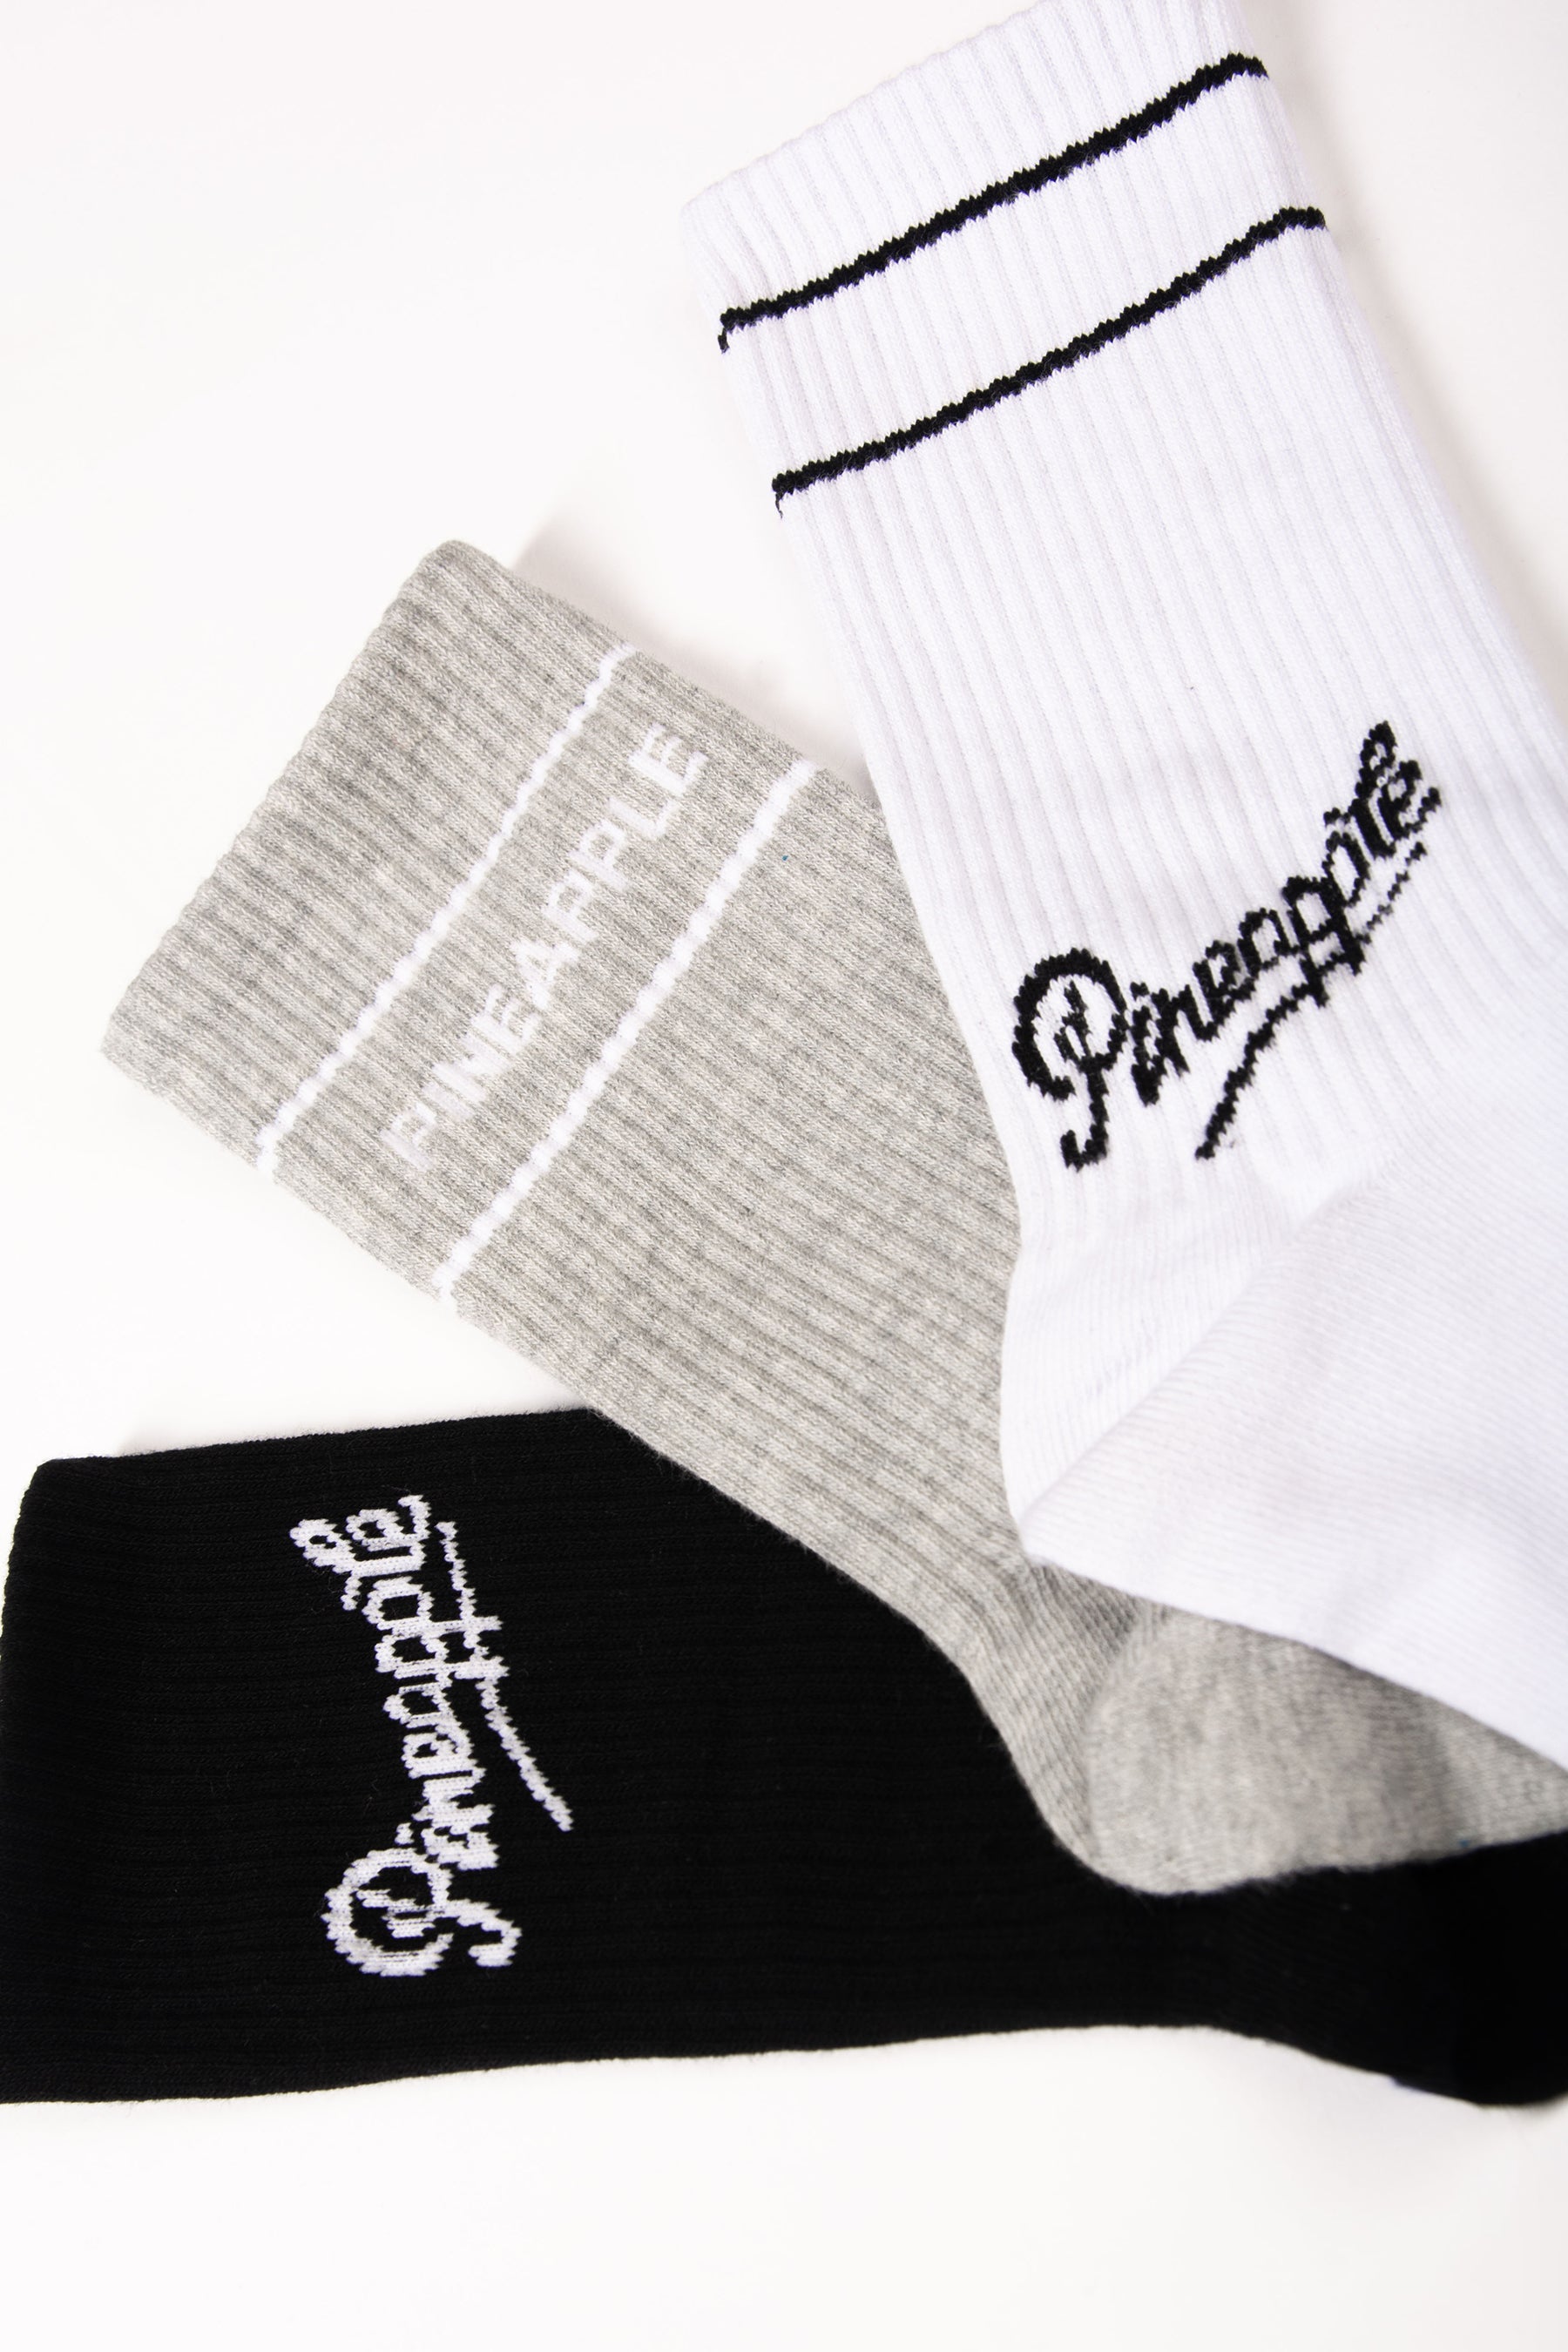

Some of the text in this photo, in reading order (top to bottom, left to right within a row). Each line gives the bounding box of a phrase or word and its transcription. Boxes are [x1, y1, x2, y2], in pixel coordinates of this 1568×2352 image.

[380, 724, 708, 1171] PINEAPPLE
[1012, 721, 1442, 1172] Pineapple
[289, 1494, 524, 1977] Pineapple
